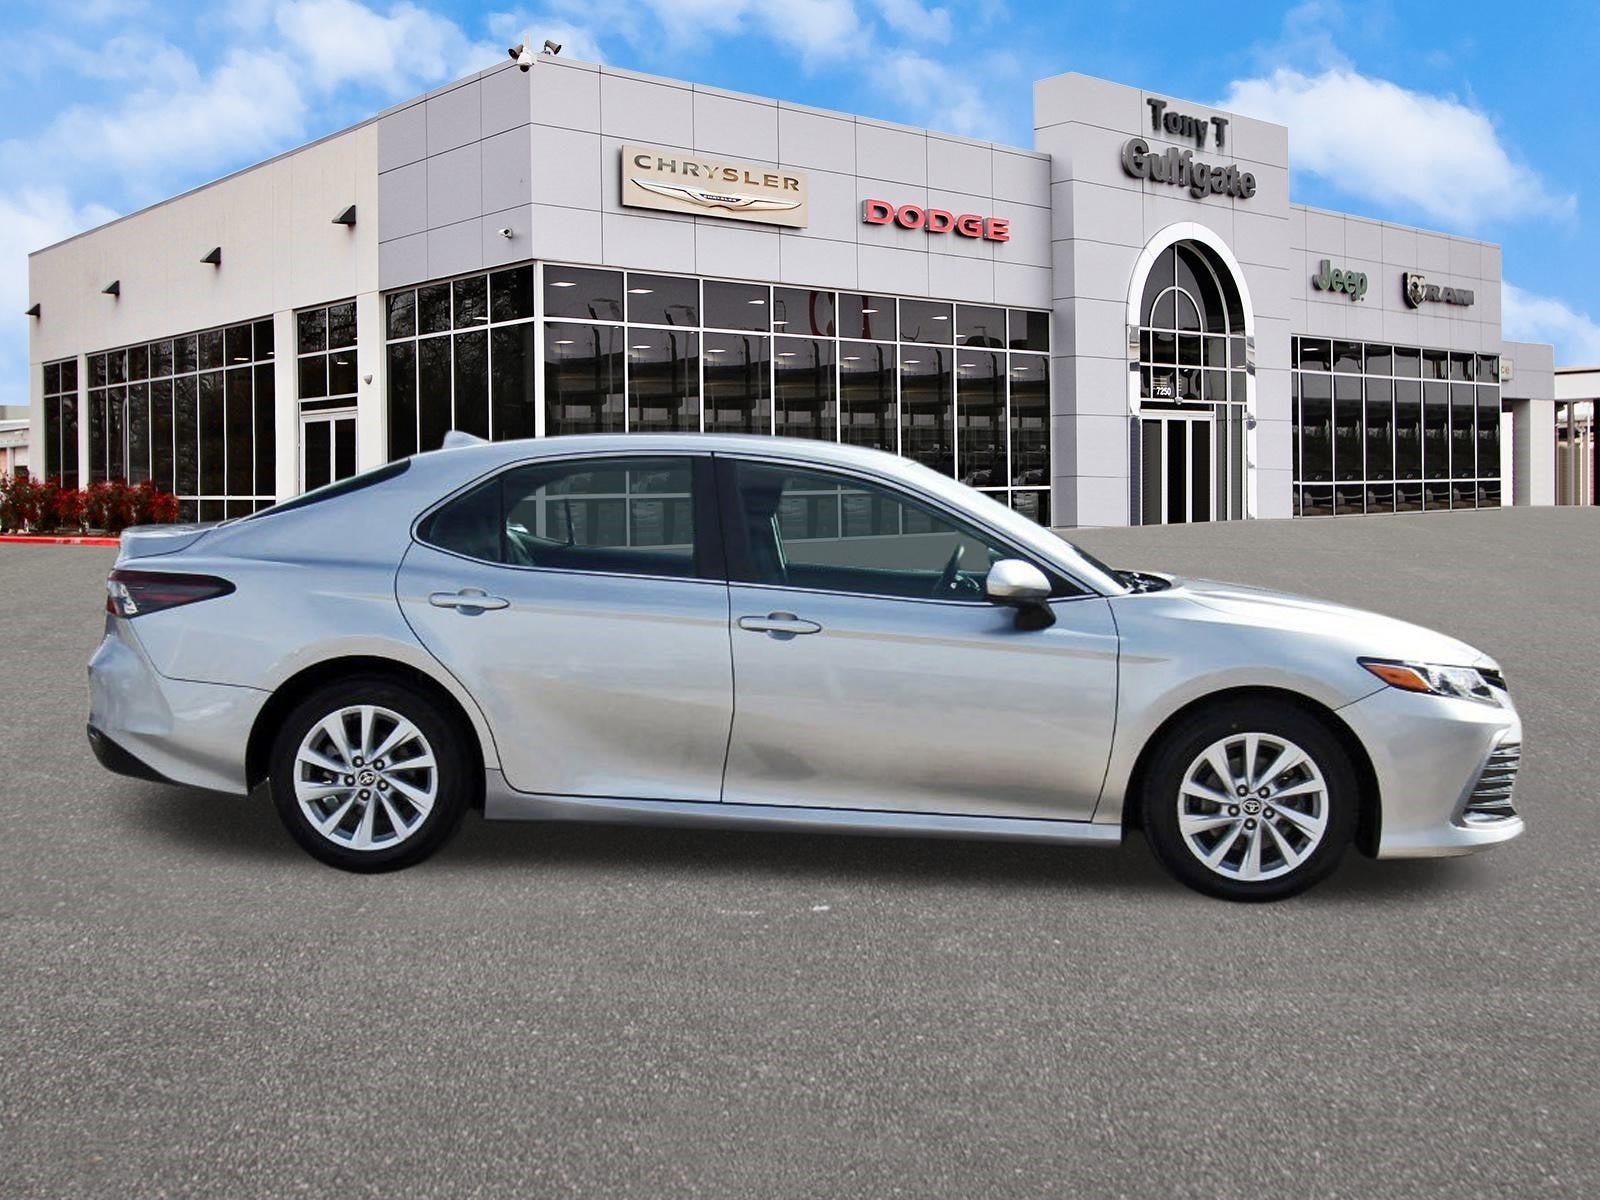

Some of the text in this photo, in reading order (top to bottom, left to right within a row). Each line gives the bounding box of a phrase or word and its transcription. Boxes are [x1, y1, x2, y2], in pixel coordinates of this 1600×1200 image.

[1147, 98, 1229, 148] Tony T
[633, 154, 800, 191] CHRYSLER
[1122, 138, 1256, 199] Gulfgate
[862, 199, 1010, 242] DODGE
[1312, 259, 1368, 301] Jeep
[1423, 283, 1475, 307] RAM
[1156, 386, 1172, 396] 7250
